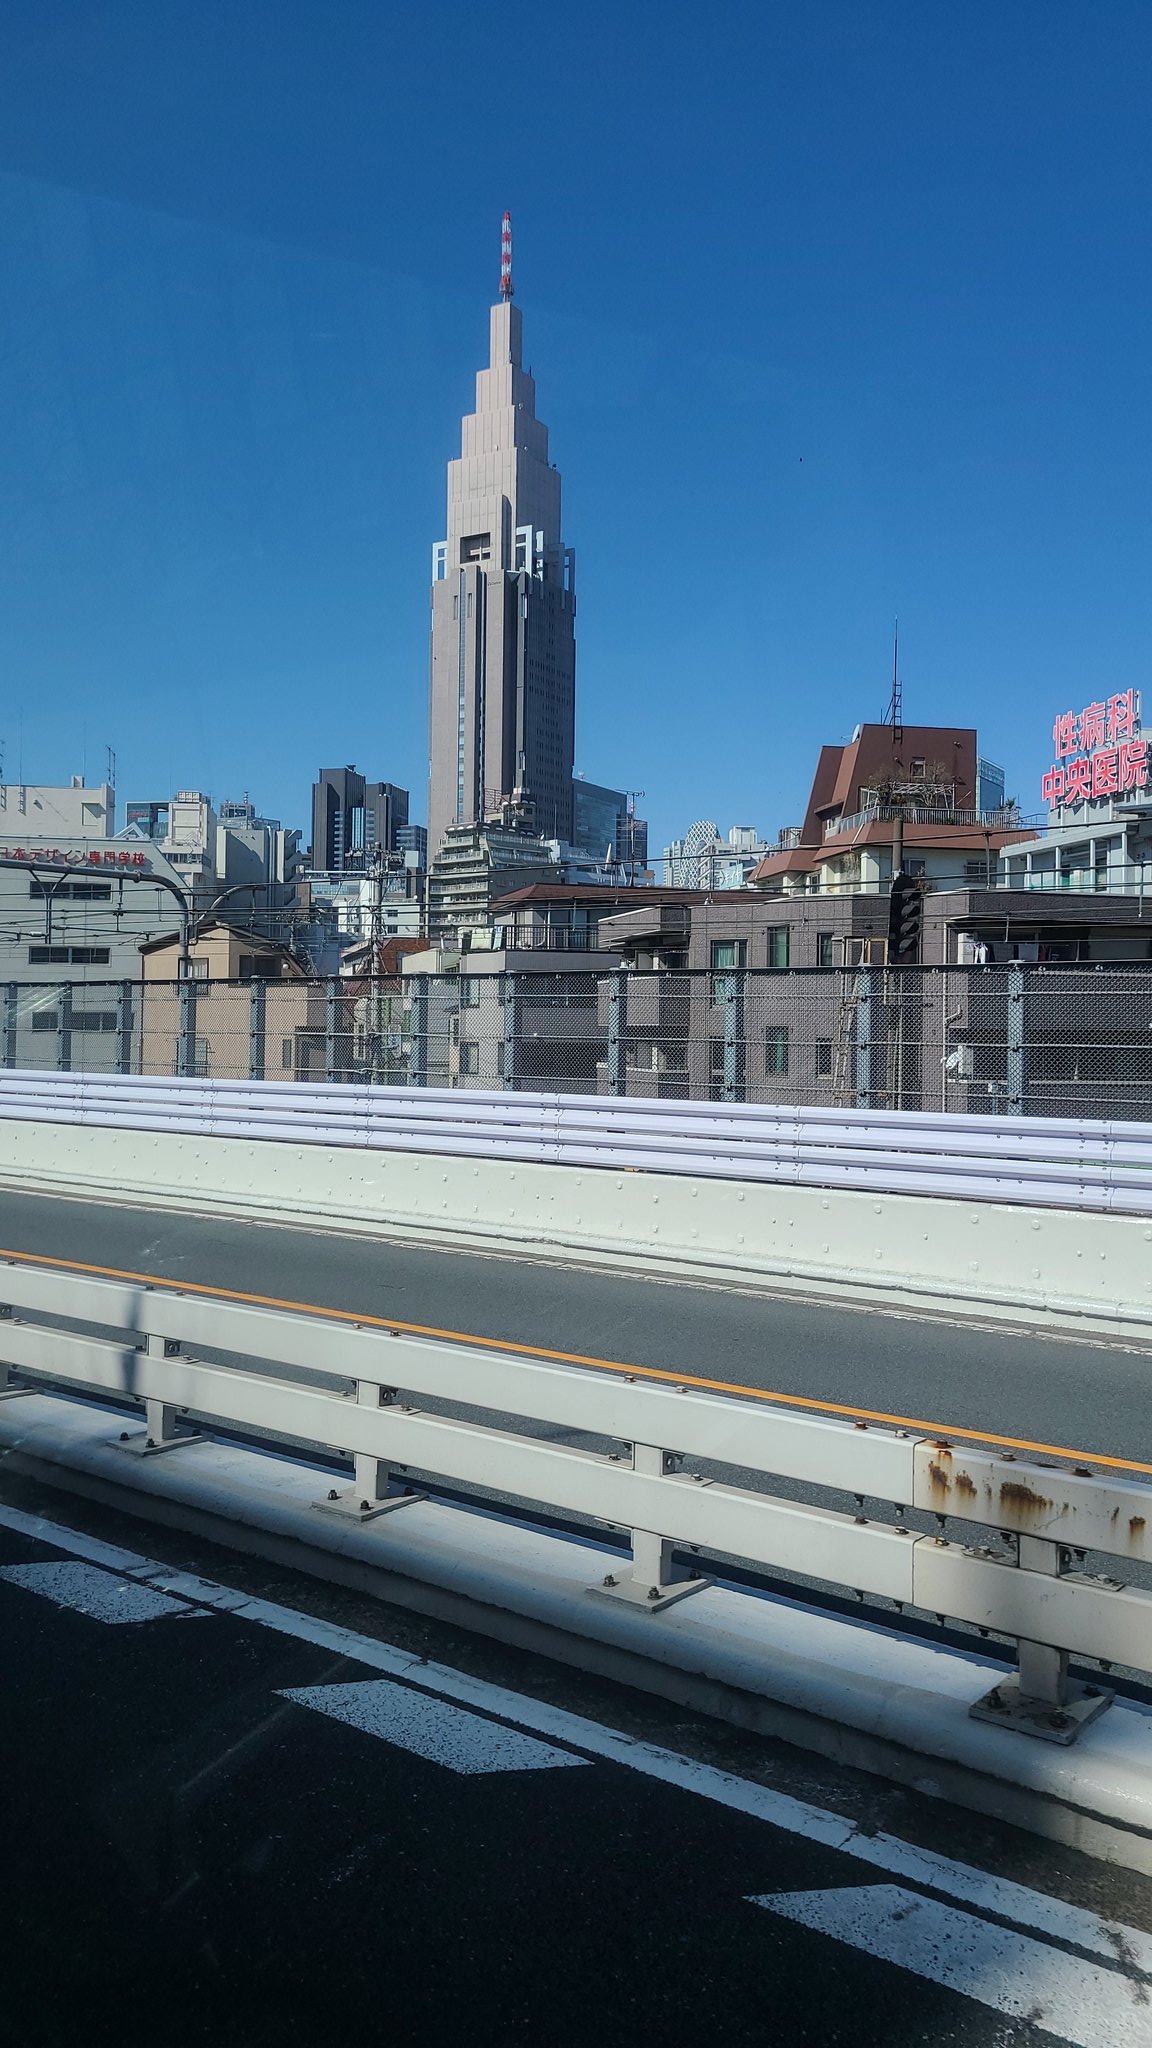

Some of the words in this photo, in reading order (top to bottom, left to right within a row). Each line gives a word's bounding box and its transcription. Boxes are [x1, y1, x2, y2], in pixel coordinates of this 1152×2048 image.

[1053, 688, 1134, 760] 性病科
[1042, 739, 1147, 808] 中央医院
